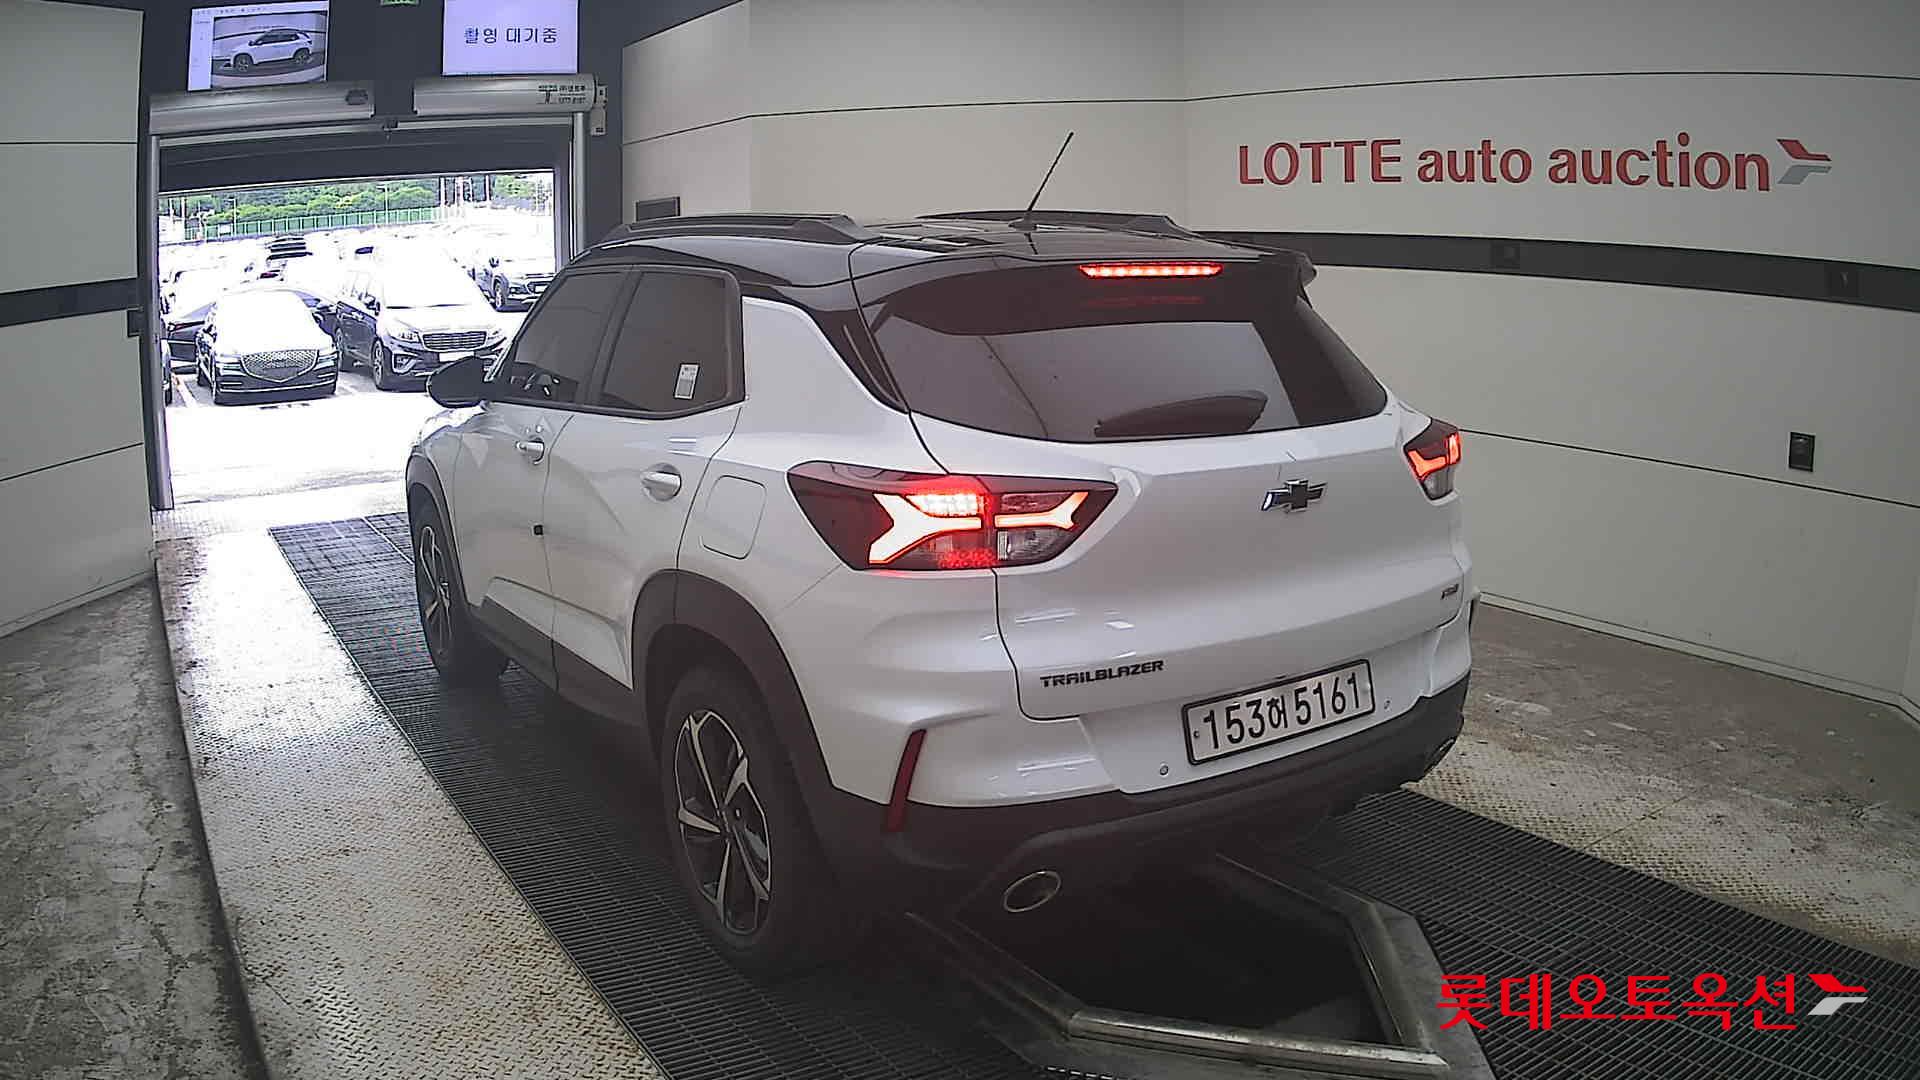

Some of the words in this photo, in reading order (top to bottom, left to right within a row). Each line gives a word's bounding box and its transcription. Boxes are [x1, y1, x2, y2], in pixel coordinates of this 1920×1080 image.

[506, 28, 557, 44] 대기중
[1239, 139, 1401, 185] LOTTE
[1417, 139, 1532, 184] auto
[1548, 132, 1770, 191] auction
[1040, 660, 1163, 687] TRAILBLAZER
[1203, 695, 1288, 749] 153허
[1294, 672, 1359, 725] 5161
